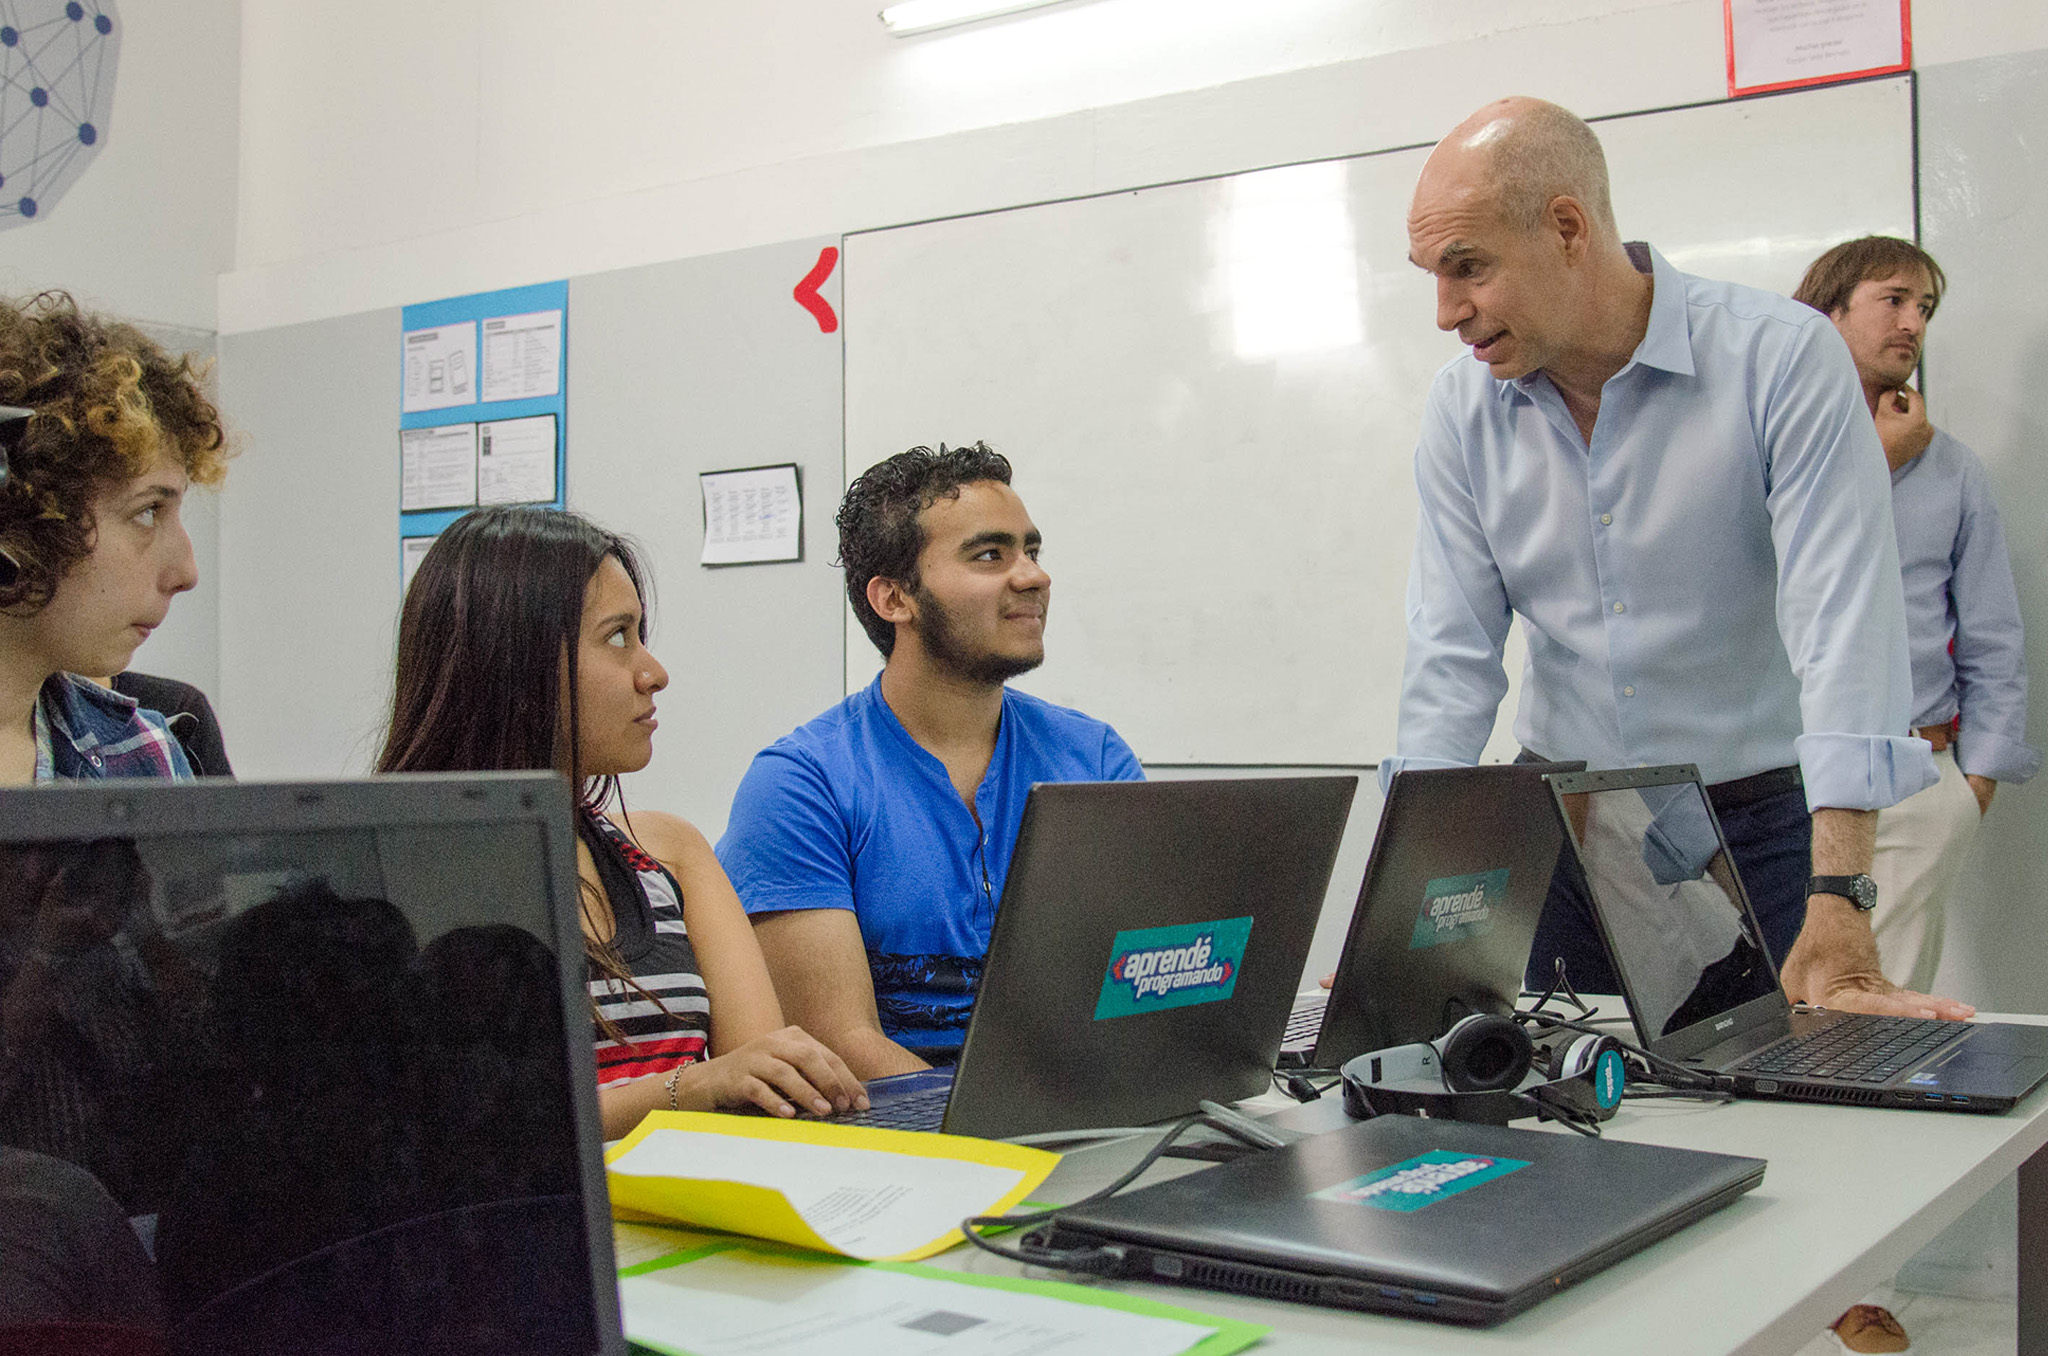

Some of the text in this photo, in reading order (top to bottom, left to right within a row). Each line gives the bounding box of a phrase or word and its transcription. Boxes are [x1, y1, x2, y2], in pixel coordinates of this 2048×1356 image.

[1430, 884, 1484, 922] aprendé
[1124, 936, 1212, 986] aprendé
[1136, 962, 1223, 999] programando
[1422, 1057, 1431, 1065] R
